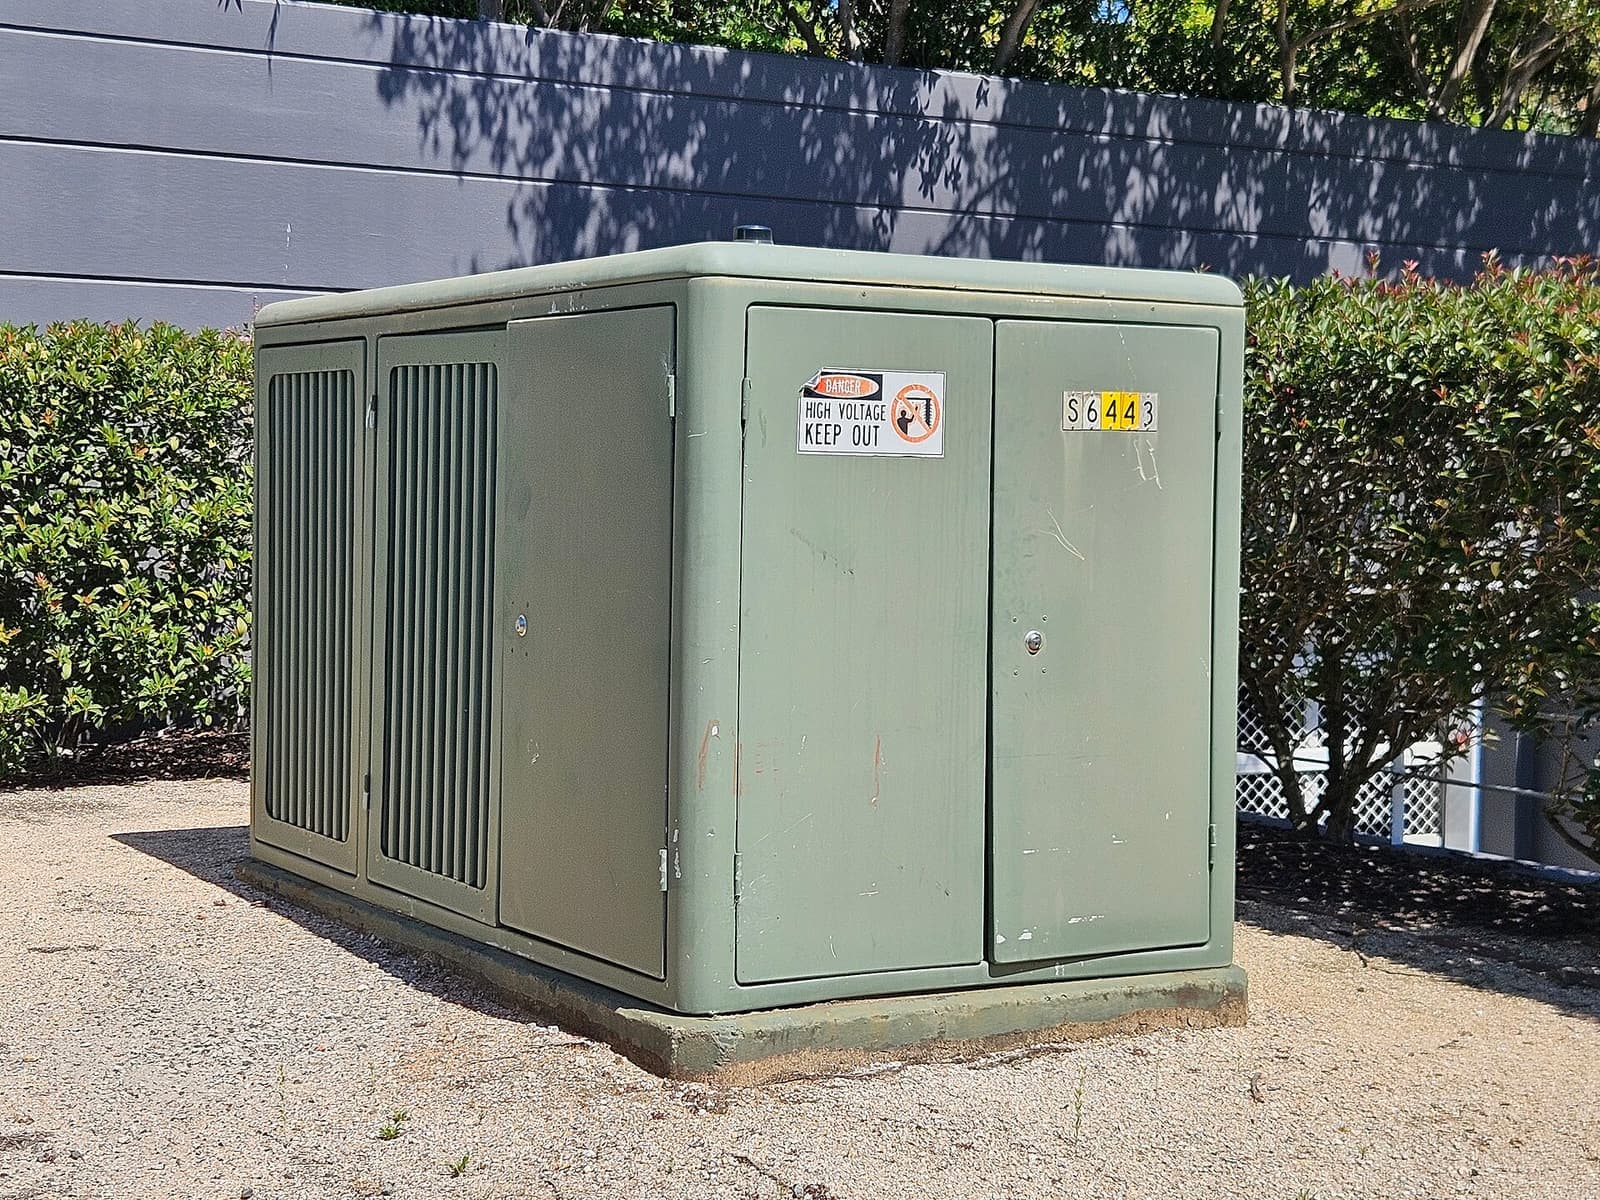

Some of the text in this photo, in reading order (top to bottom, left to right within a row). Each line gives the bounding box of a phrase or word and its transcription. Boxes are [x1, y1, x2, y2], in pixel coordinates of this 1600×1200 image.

[825, 378, 861, 394] DANGER
[805, 401, 887, 422] HIGH VOLTAGE
[1067, 398, 1153, 427] S6443
[805, 423, 880, 447] KEEP OUT
